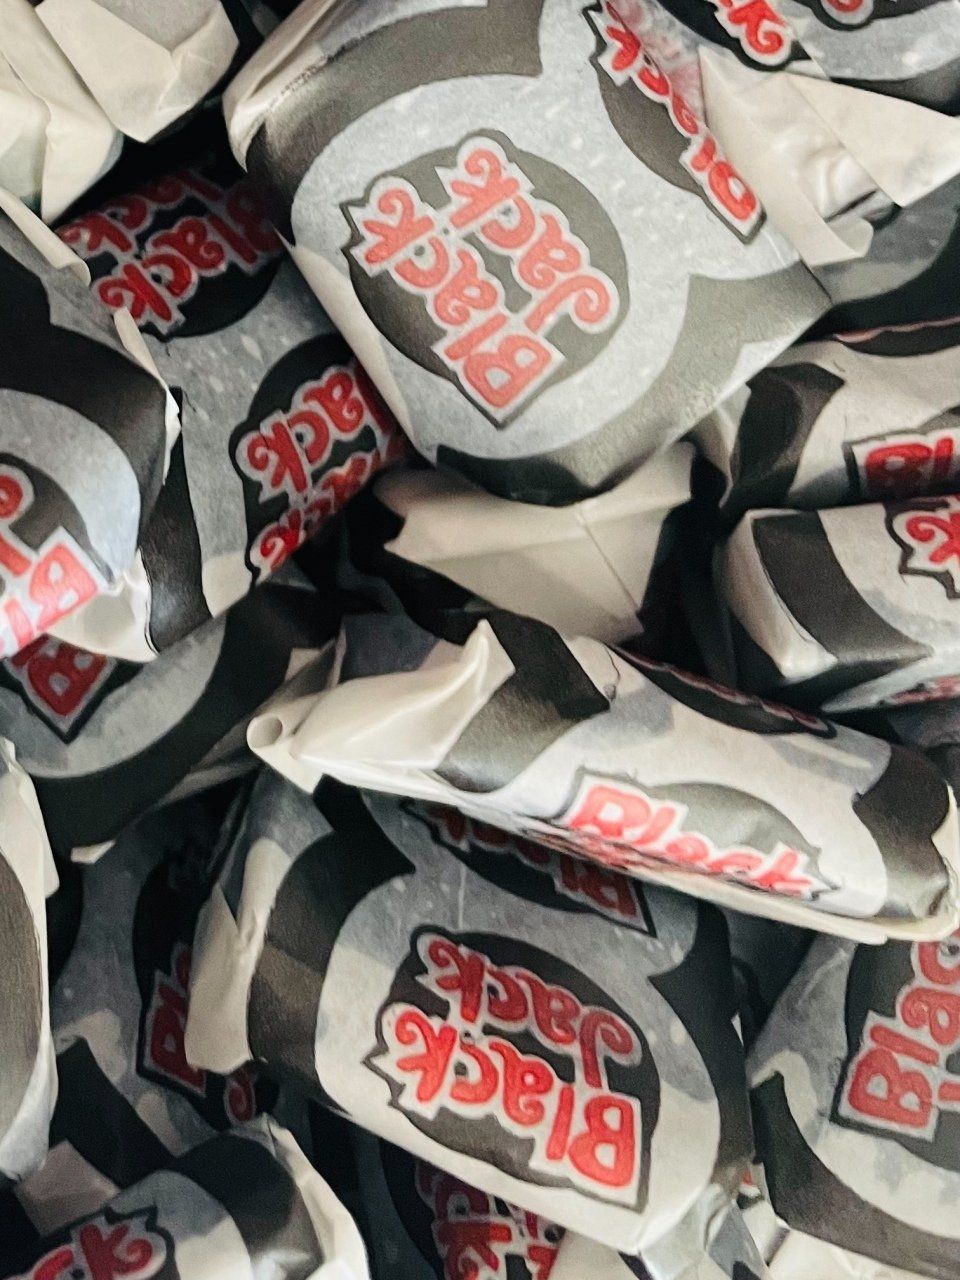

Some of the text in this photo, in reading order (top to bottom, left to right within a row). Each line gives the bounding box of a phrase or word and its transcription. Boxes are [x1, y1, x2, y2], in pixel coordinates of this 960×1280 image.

[361, 185, 554, 410] Black
[448, 147, 612, 332] Jack
[395, 1010, 635, 1189] Black
[428, 939, 635, 1088] Jack
